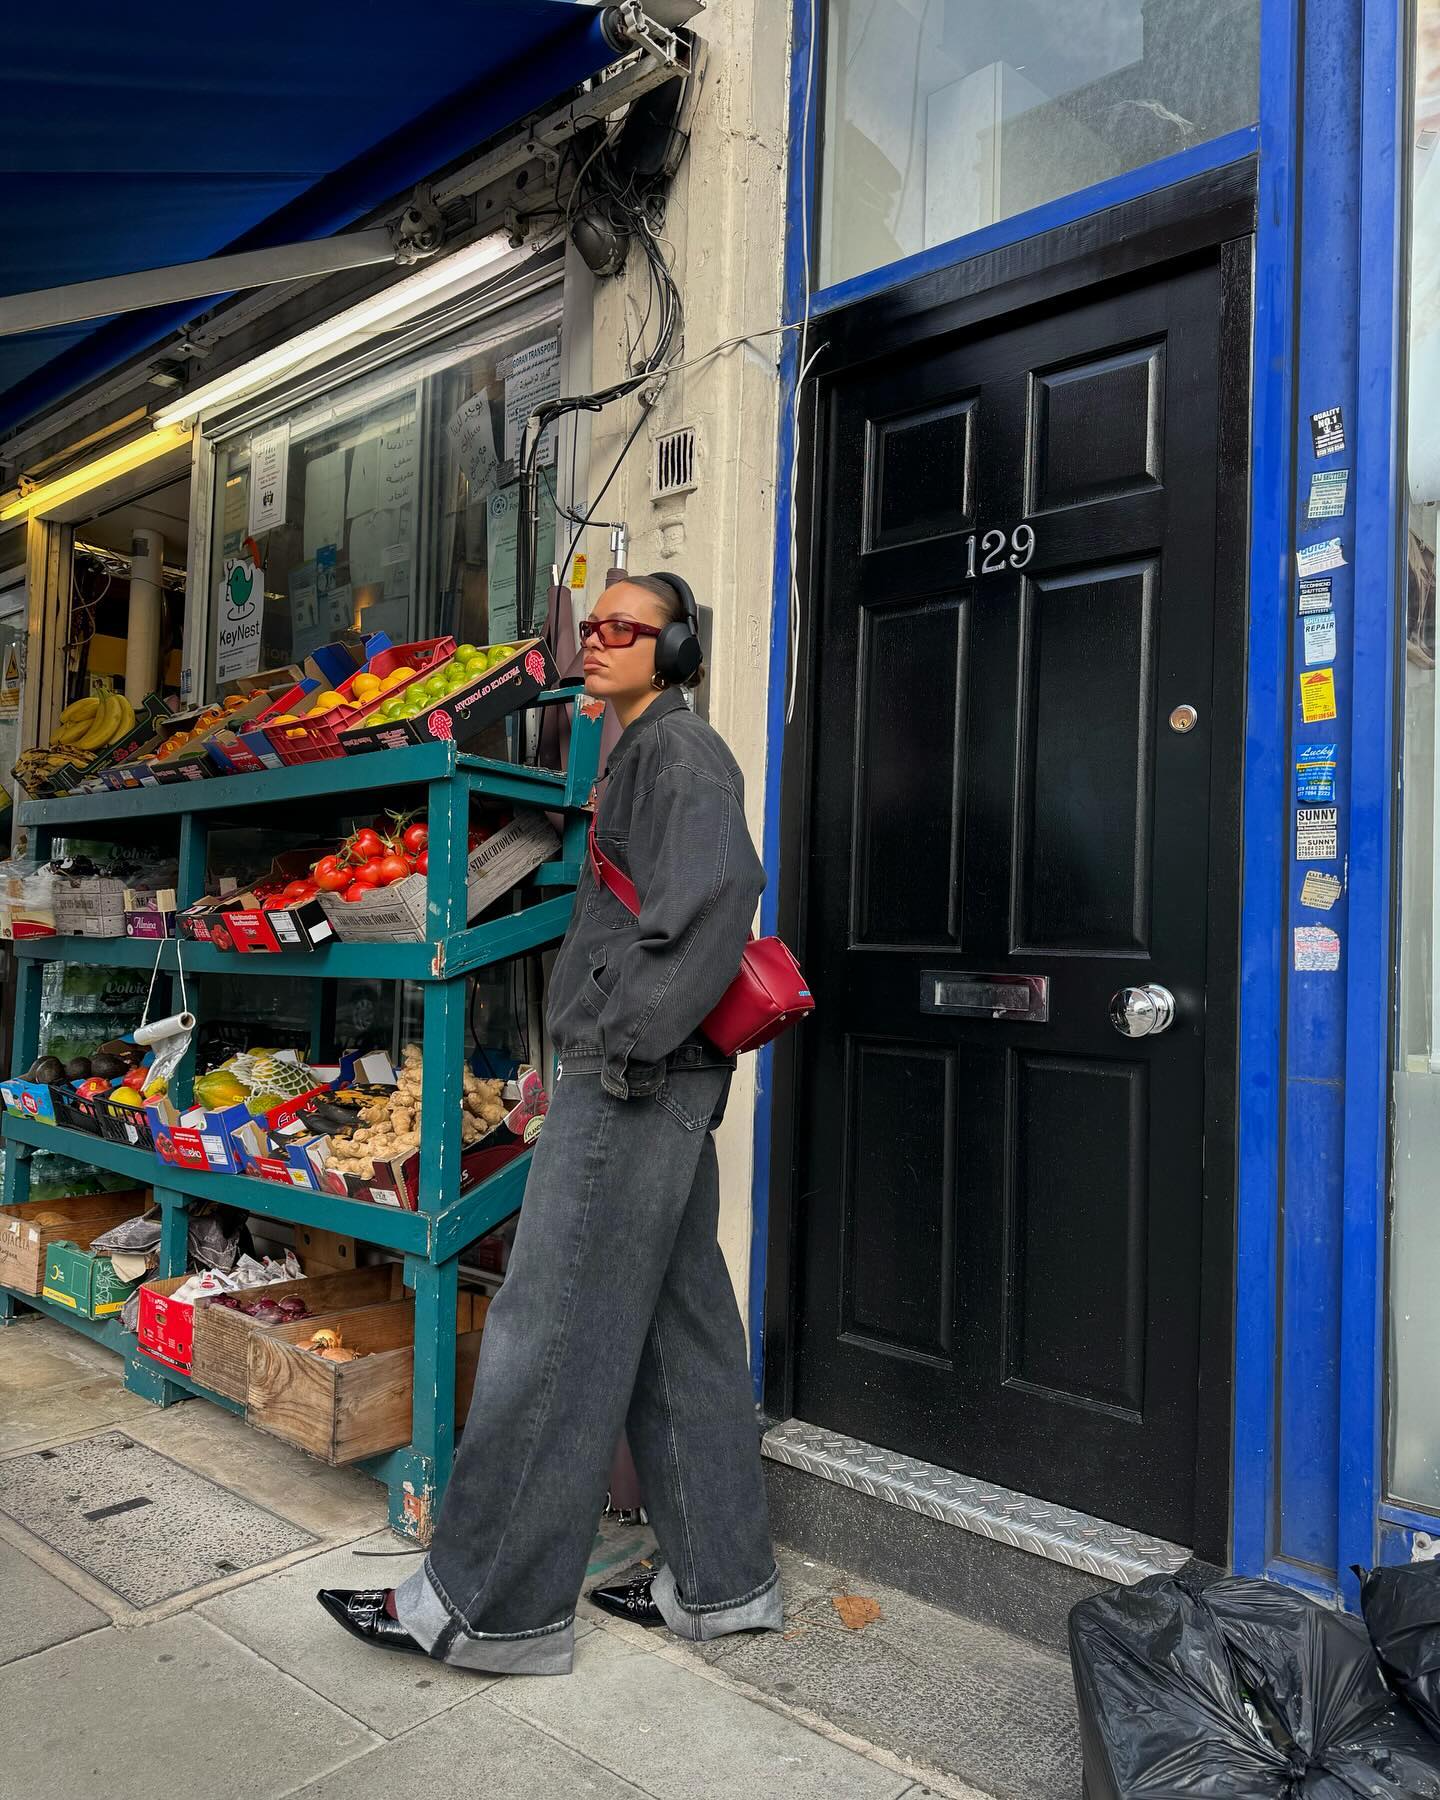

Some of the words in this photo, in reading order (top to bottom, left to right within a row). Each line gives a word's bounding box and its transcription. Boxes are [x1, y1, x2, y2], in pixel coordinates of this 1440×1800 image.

[528, 340, 558, 360] TRANSPORT
[1313, 406, 1340, 421] QUALITY
[1318, 415, 1337, 428] NO.1
[965, 524, 1035, 578] 129
[219, 620, 260, 647] KeyNest
[1305, 622, 1335, 633] REPAIR
[490, 665, 520, 690] PRODUCE
[481, 685, 491, 696] OF
[454, 688, 482, 712] JORDAN
[1300, 744, 1336, 759] Lucky
[1299, 810, 1336, 821] SUNNY
[106, 981, 147, 995] Volvic
